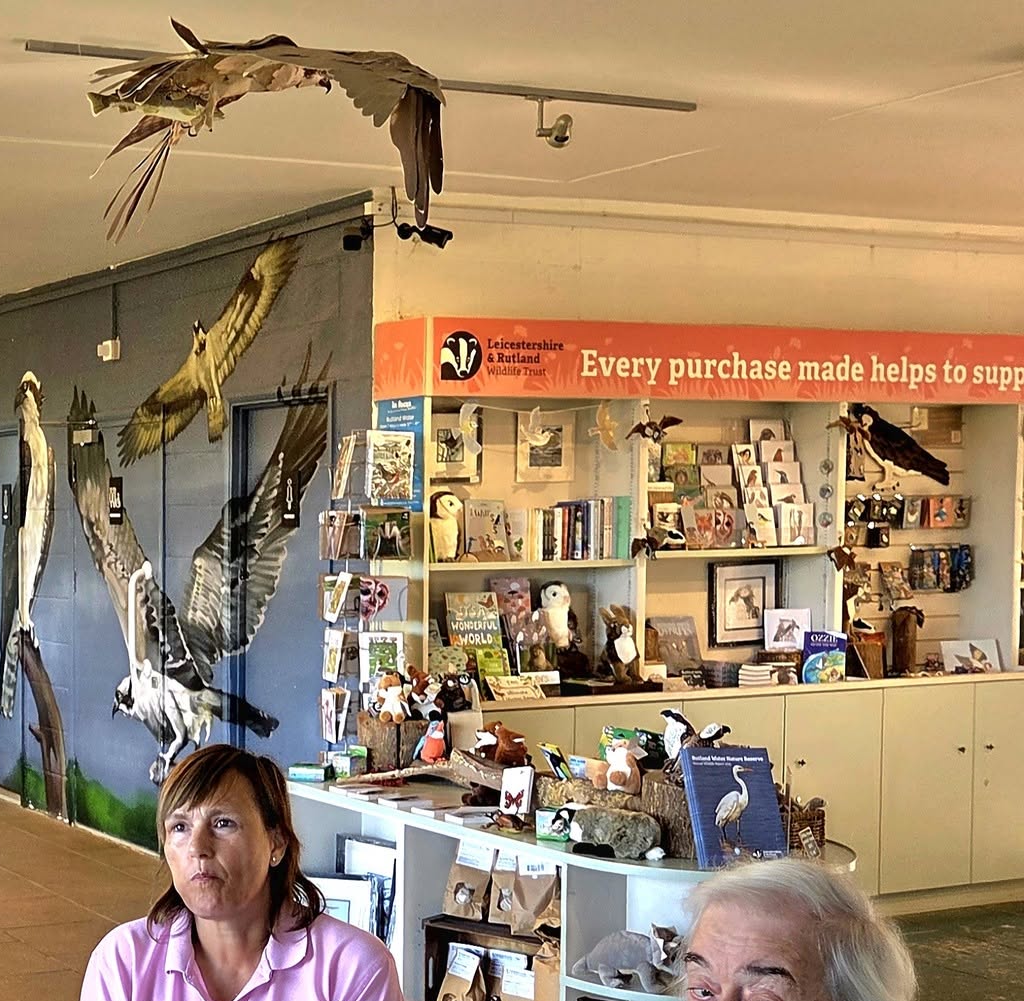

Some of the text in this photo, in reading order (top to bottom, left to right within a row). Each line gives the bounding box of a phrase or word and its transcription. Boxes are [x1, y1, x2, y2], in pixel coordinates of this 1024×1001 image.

[487, 338, 564, 352] Leicestershire
[487, 353, 540, 364] & Rutland
[487, 366, 547, 377] Wildlife Trust
[580, 349, 1024, 391] Every purchase made helps to supp
[451, 619, 498, 631] WONDERFUL
[458, 633, 493, 646] WORLD
